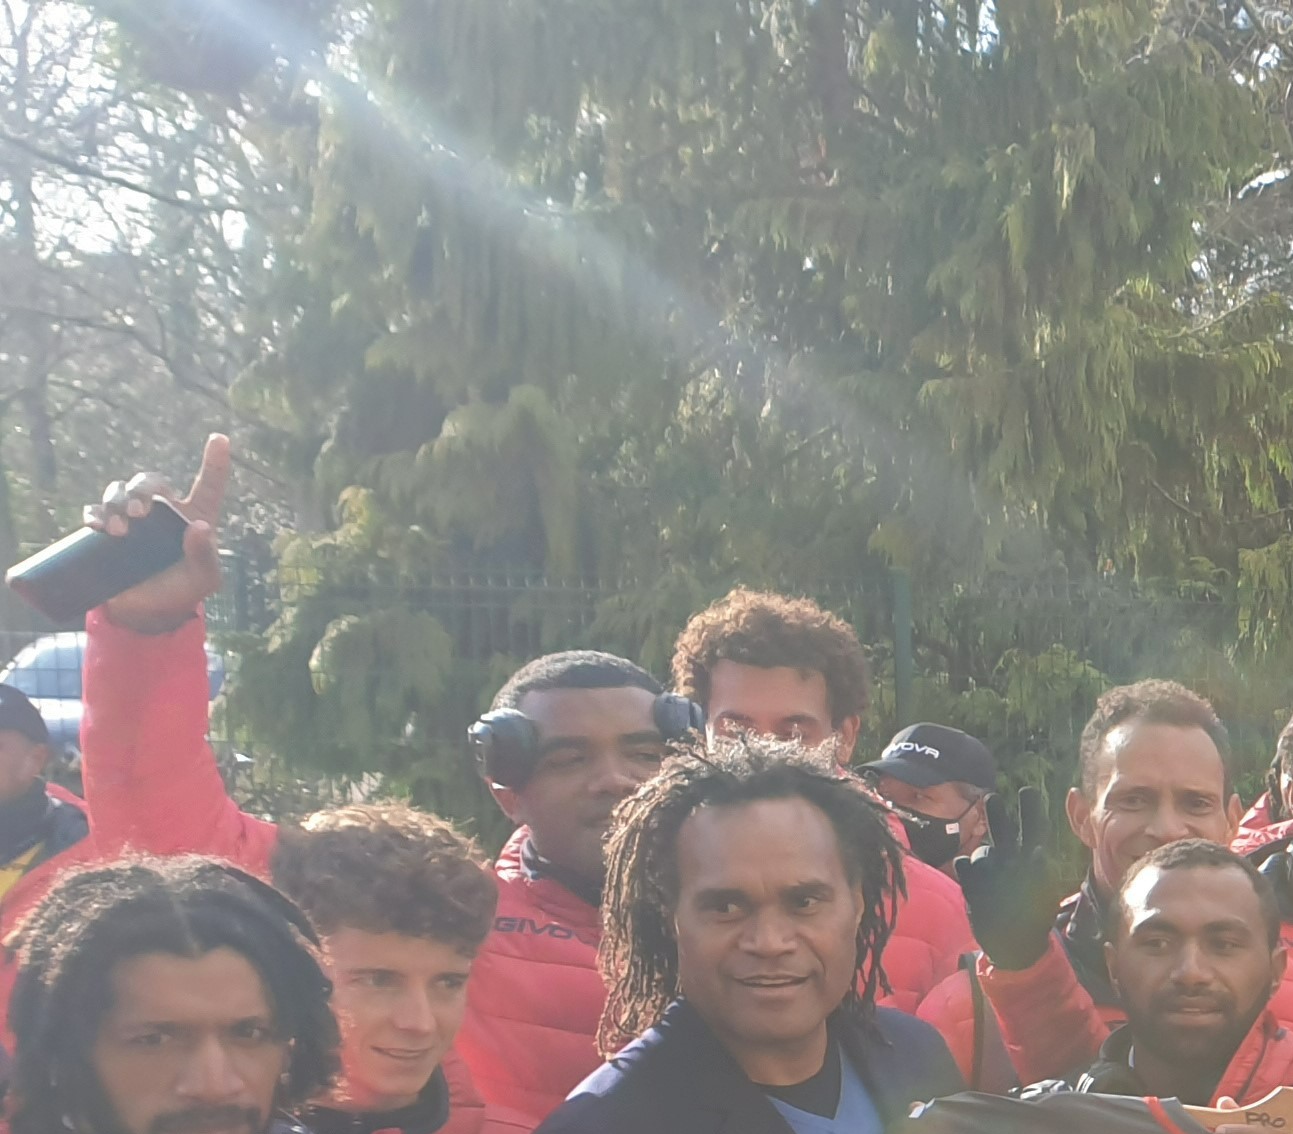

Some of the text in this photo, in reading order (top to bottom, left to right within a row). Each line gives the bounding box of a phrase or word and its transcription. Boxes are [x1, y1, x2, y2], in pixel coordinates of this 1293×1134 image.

[881, 742, 939, 759] VOVA
[496, 916, 575, 940] GIVO
[1245, 1111, 1287, 1129] PRO
